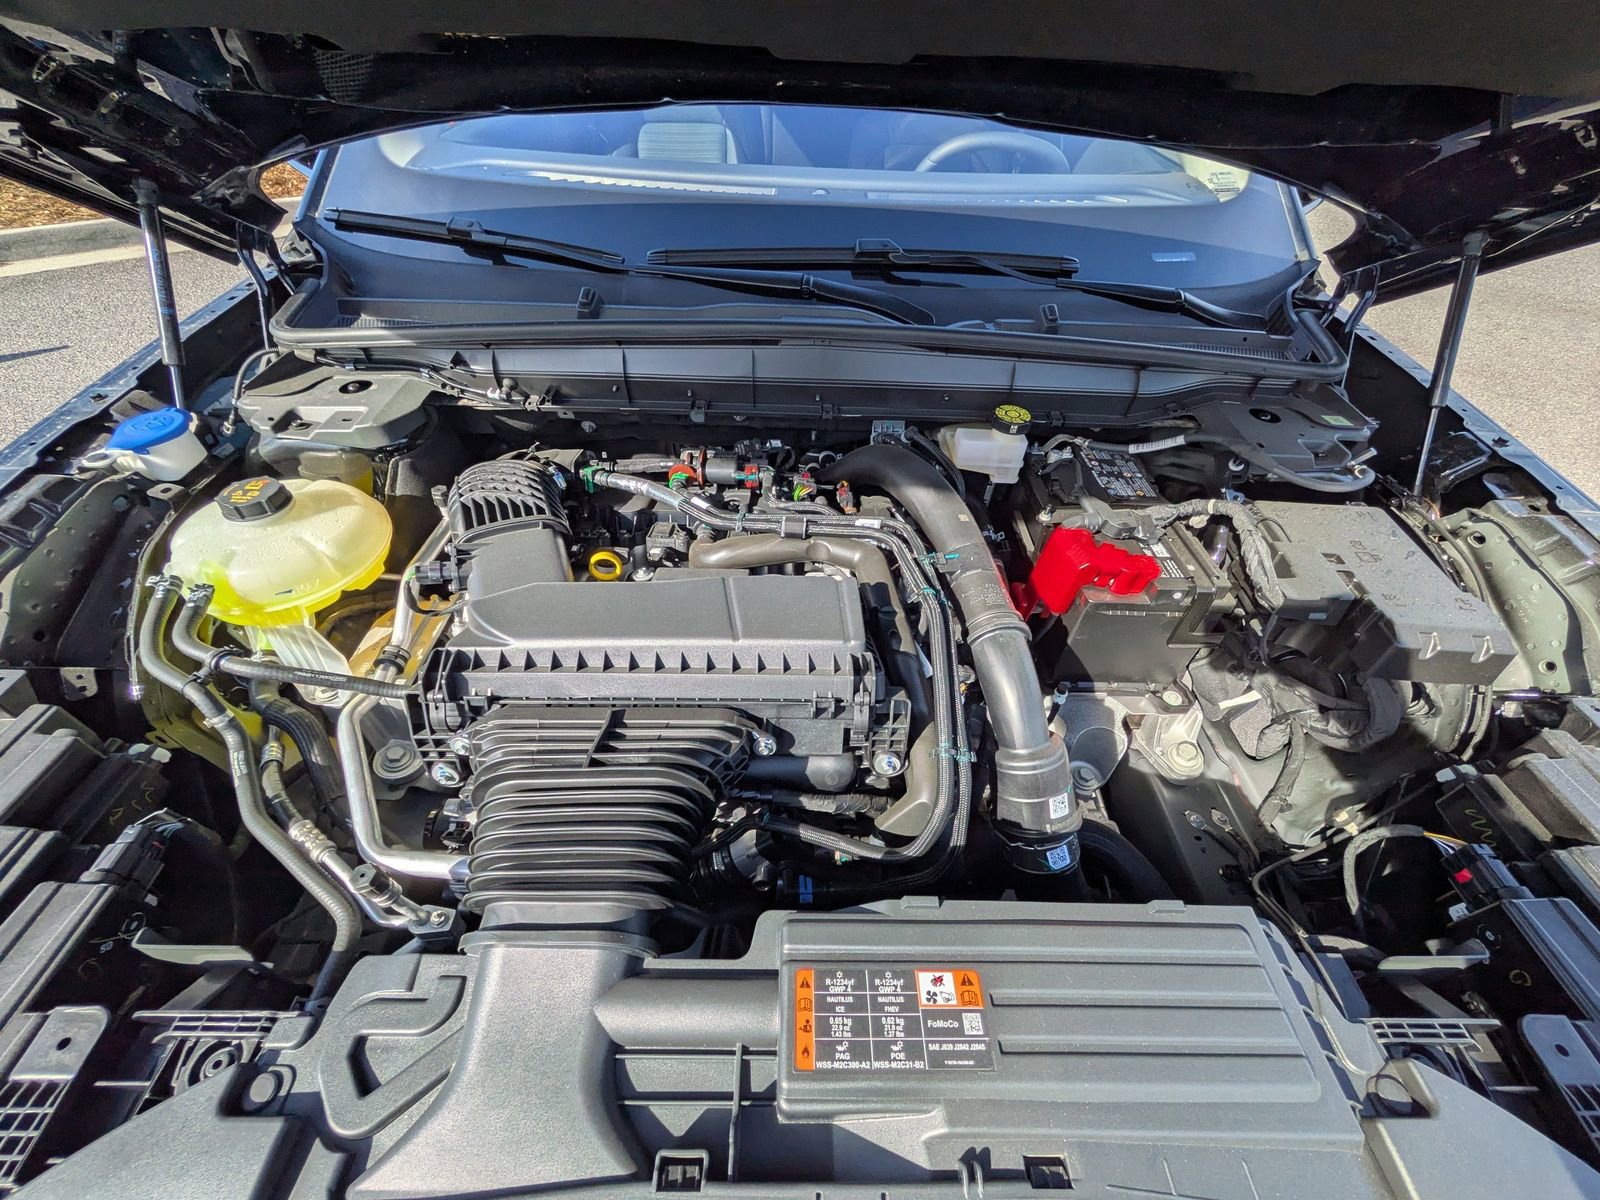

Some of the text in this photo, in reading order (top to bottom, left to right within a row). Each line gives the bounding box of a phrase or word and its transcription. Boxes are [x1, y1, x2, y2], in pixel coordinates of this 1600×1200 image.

[825, 978, 854, 986] R-1234yf
[875, 978, 904, 986] R-1234yf
[844, 1017, 852, 1026] kg
[896, 1017, 904, 1026] kg
